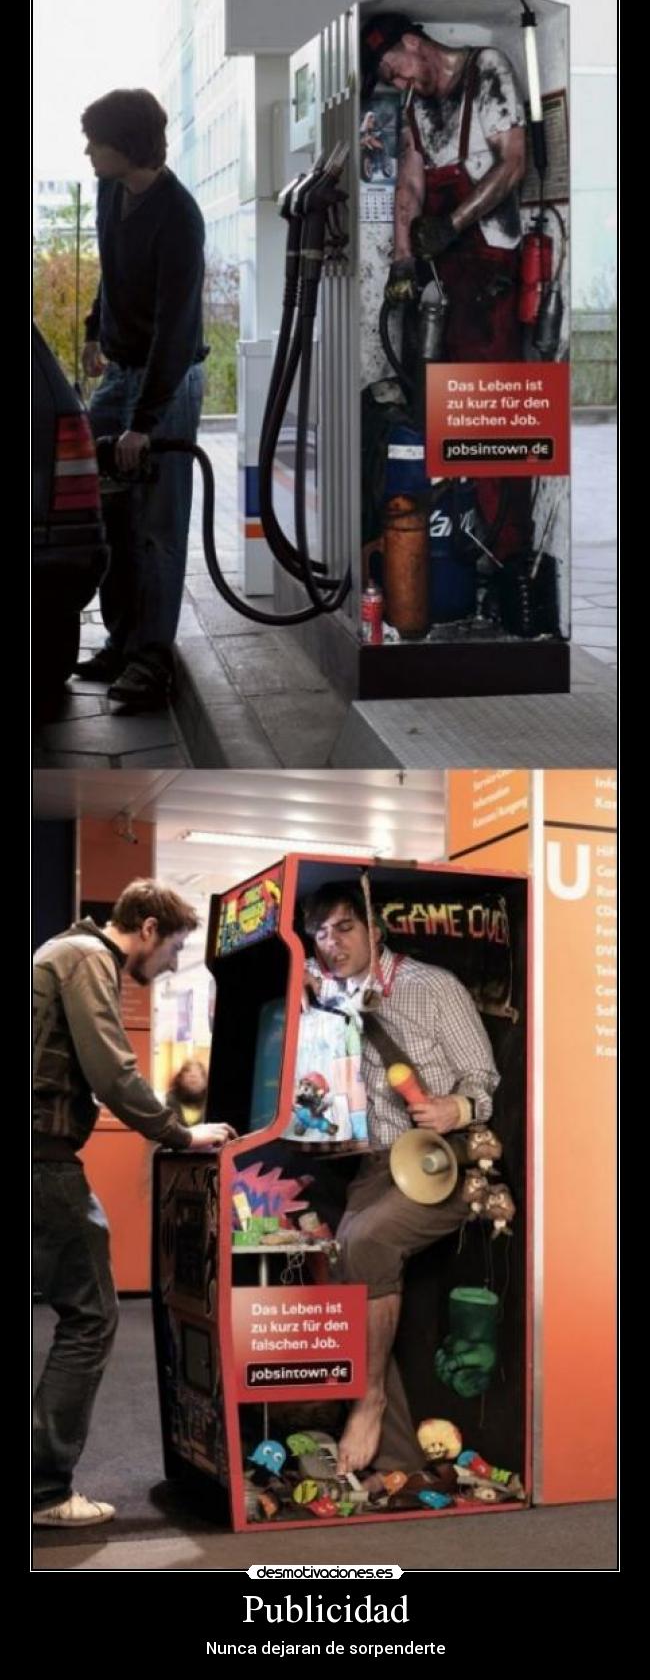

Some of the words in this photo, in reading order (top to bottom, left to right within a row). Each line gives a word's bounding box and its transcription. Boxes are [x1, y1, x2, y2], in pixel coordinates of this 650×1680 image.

[448, 380, 474, 391] Das
[479, 380, 521, 392] Leben
[526, 380, 542, 391] ist
[447, 399, 463, 409] zu
[467, 397, 497, 409] kurz
[501, 397, 520, 409] für
[524, 397, 549, 409] den
[447, 414, 506, 426] falschen
[510, 414, 540, 426] Job.
[547, 840, 591, 899] U
[383, 902, 463, 937] GAME
[251, 1303, 277, 1316] Das
[282, 1302, 322, 1315] Leben
[326, 1302, 342, 1313] ist
[251, 1323, 267, 1333] zu
[270, 1321, 299, 1332] kurz
[302, 1320, 321, 1332] für
[324, 1320, 349, 1331] den
[251, 1338, 308, 1351] falschen
[311, 1337, 340, 1349] Job.
